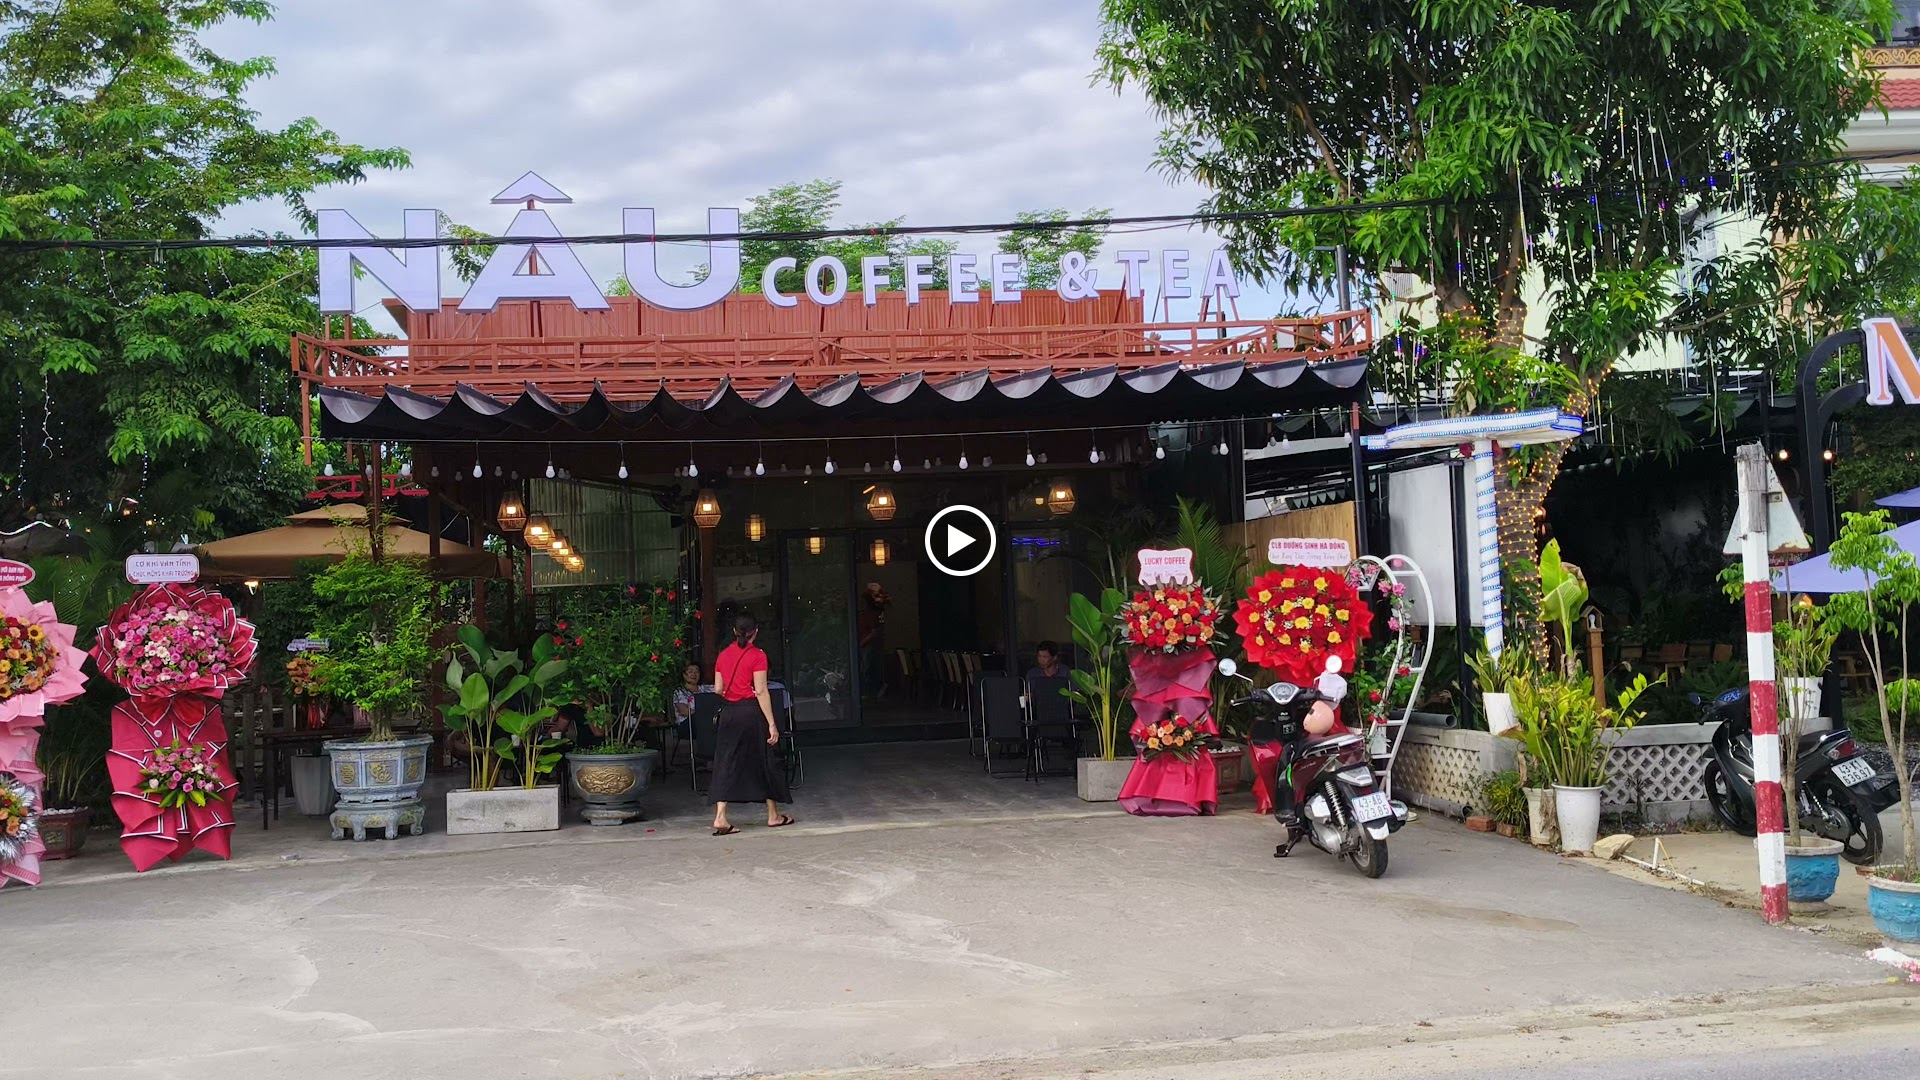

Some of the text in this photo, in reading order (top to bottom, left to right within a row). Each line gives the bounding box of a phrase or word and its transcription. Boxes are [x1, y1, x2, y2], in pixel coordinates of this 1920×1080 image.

[317, 170, 1241, 314] NÂU COFFEE & TEA
[1304, 542, 1318, 550] SINH
[1144, 556, 1186, 565] LUCKY COFFEE
[1842, 767, 1872, 785] 636.97
[1358, 794, 1383, 809] 43-AB
[1359, 804, 1390, 821] 023.85
